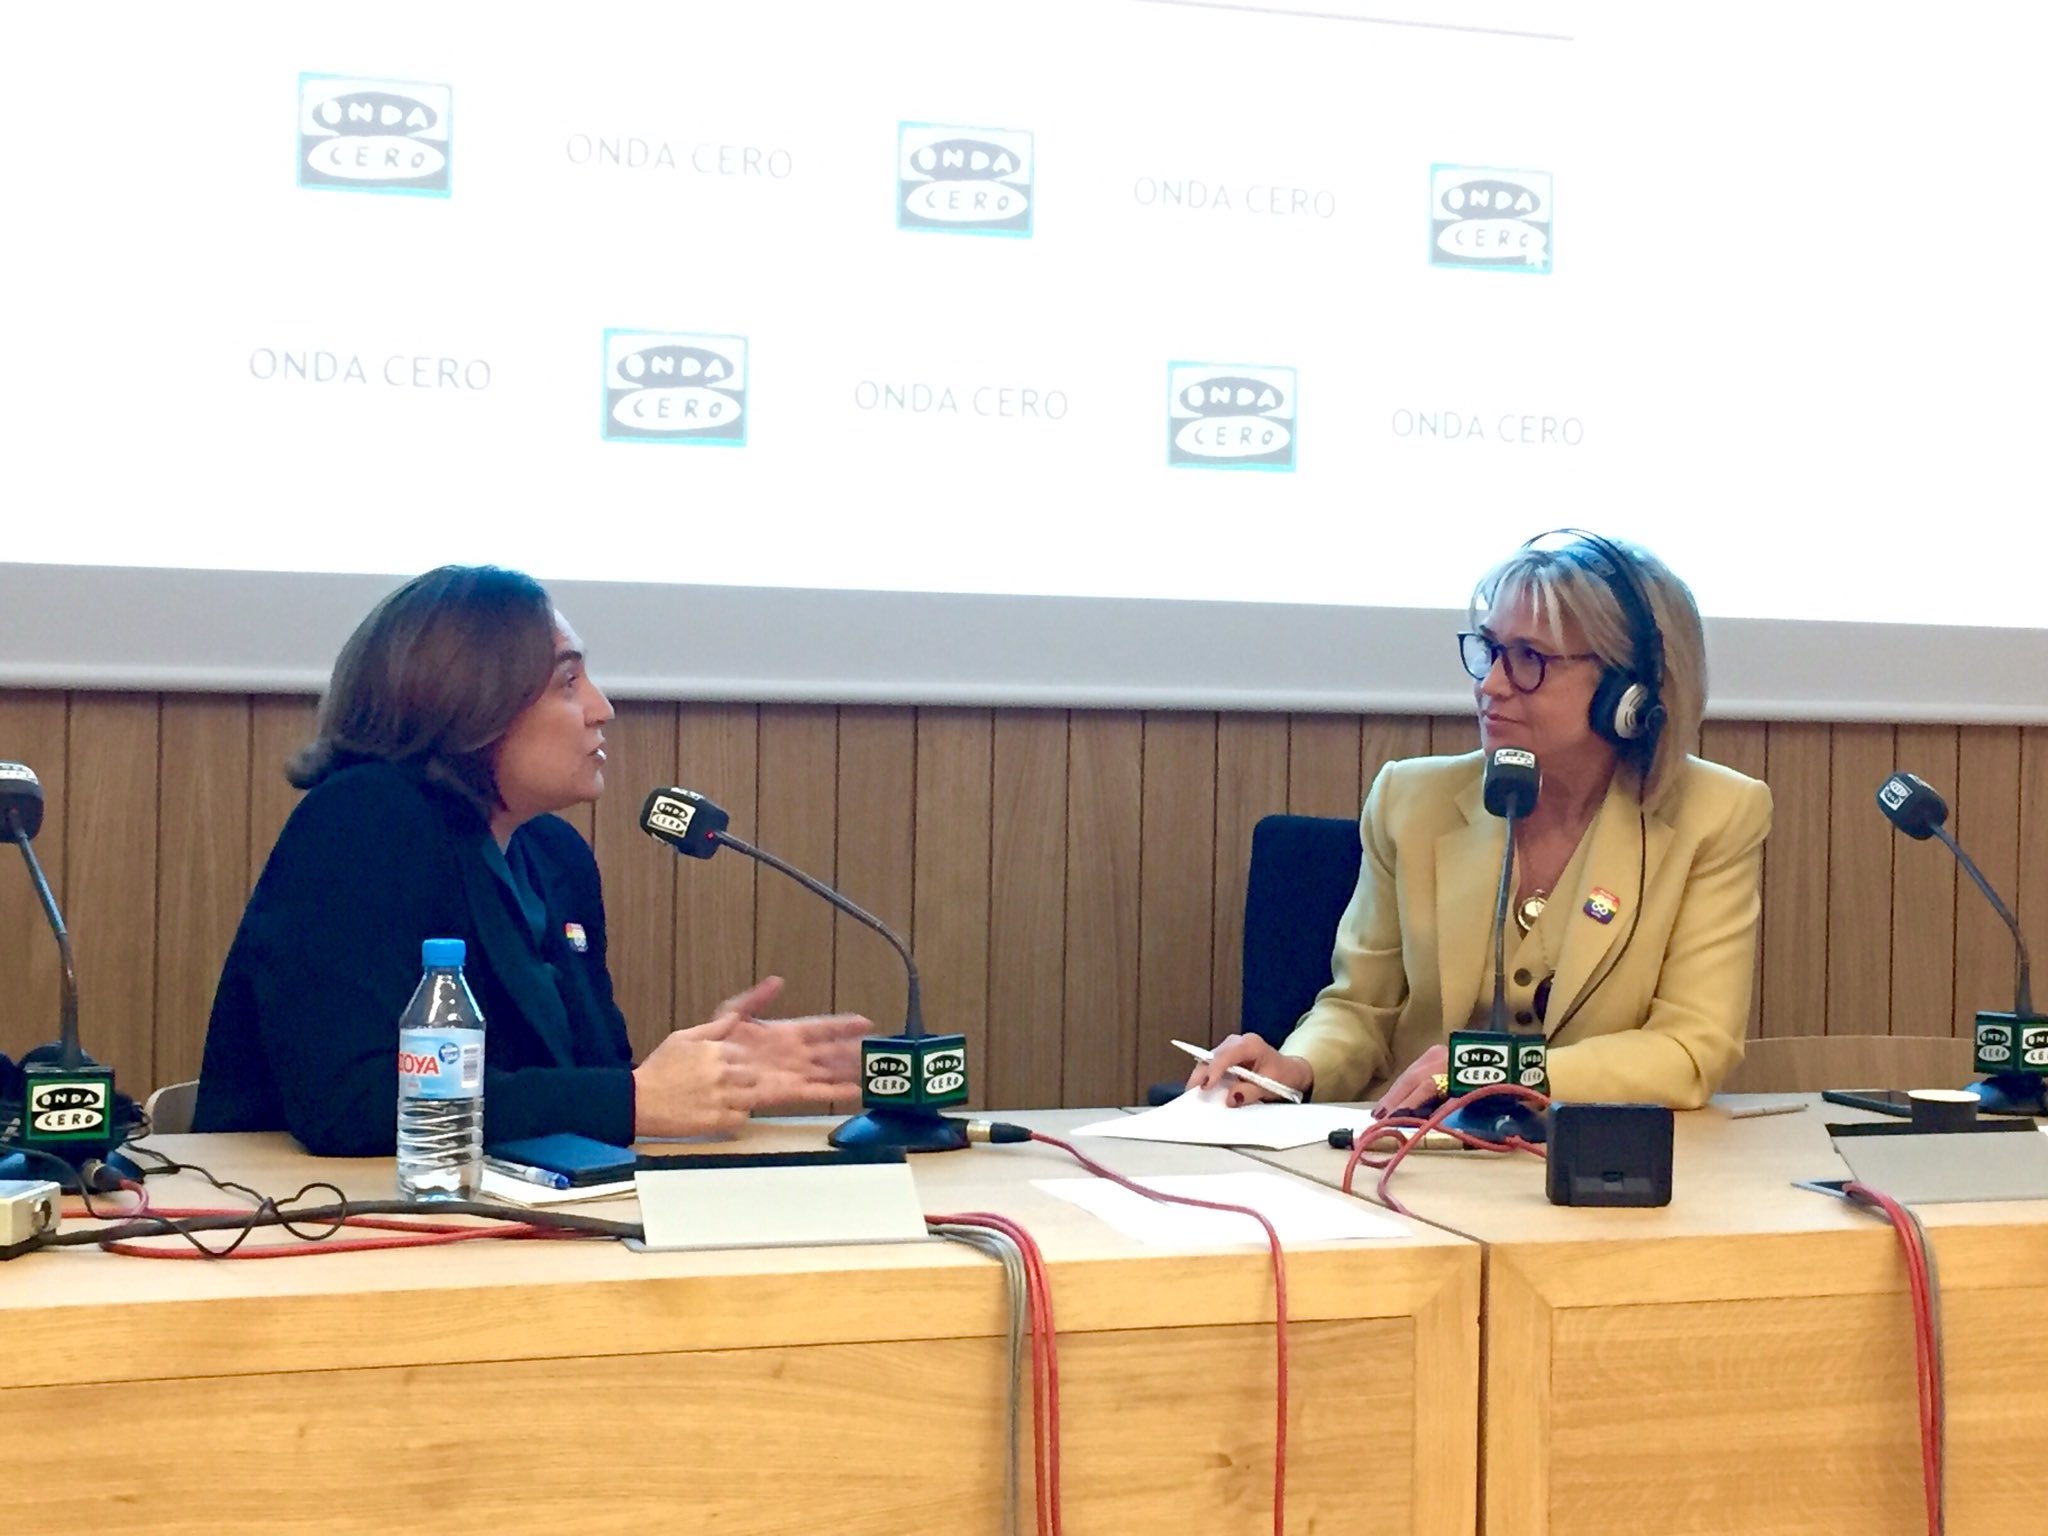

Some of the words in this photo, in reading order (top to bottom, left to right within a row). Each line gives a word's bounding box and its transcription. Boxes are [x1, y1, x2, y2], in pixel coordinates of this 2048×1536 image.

[321, 99, 428, 129] ONDA
[329, 145, 426, 169] CERO
[566, 133, 676, 170] ONDA
[692, 143, 793, 179] CERO
[918, 146, 1013, 173] ONDA
[925, 190, 1009, 211] CERO
[1134, 176, 1232, 211] ONDA
[1246, 183, 1336, 219] CERO
[1448, 187, 1533, 212] ONDA
[250, 347, 367, 385] ONDA
[383, 355, 491, 391] CERO
[625, 353, 725, 379] ONDA
[855, 379, 959, 414] ONDA
[973, 386, 1068, 420] CERO
[1187, 385, 1276, 408] ONDA
[633, 397, 722, 418] CERO
[1194, 426, 1274, 446] CERO
[1392, 408, 1485, 441] ONDA
[1498, 414, 1584, 446] CERO
[659, 803, 686, 818] ONDA
[656, 815, 681, 829] CERO
[2028, 1035, 2048, 1045] ON
[928, 1058, 960, 1072] ONDA
[1461, 1051, 1501, 1063] ONDA
[2030, 1050, 2048, 1061] CE
[871, 1061, 905, 1072] ONDA
[1463, 1070, 1500, 1081] CERO
[874, 1080, 906, 1091] CERO
[931, 1077, 960, 1090] CERO
[41, 1093, 96, 1106] ONDA
[44, 1114, 95, 1127] CERO
